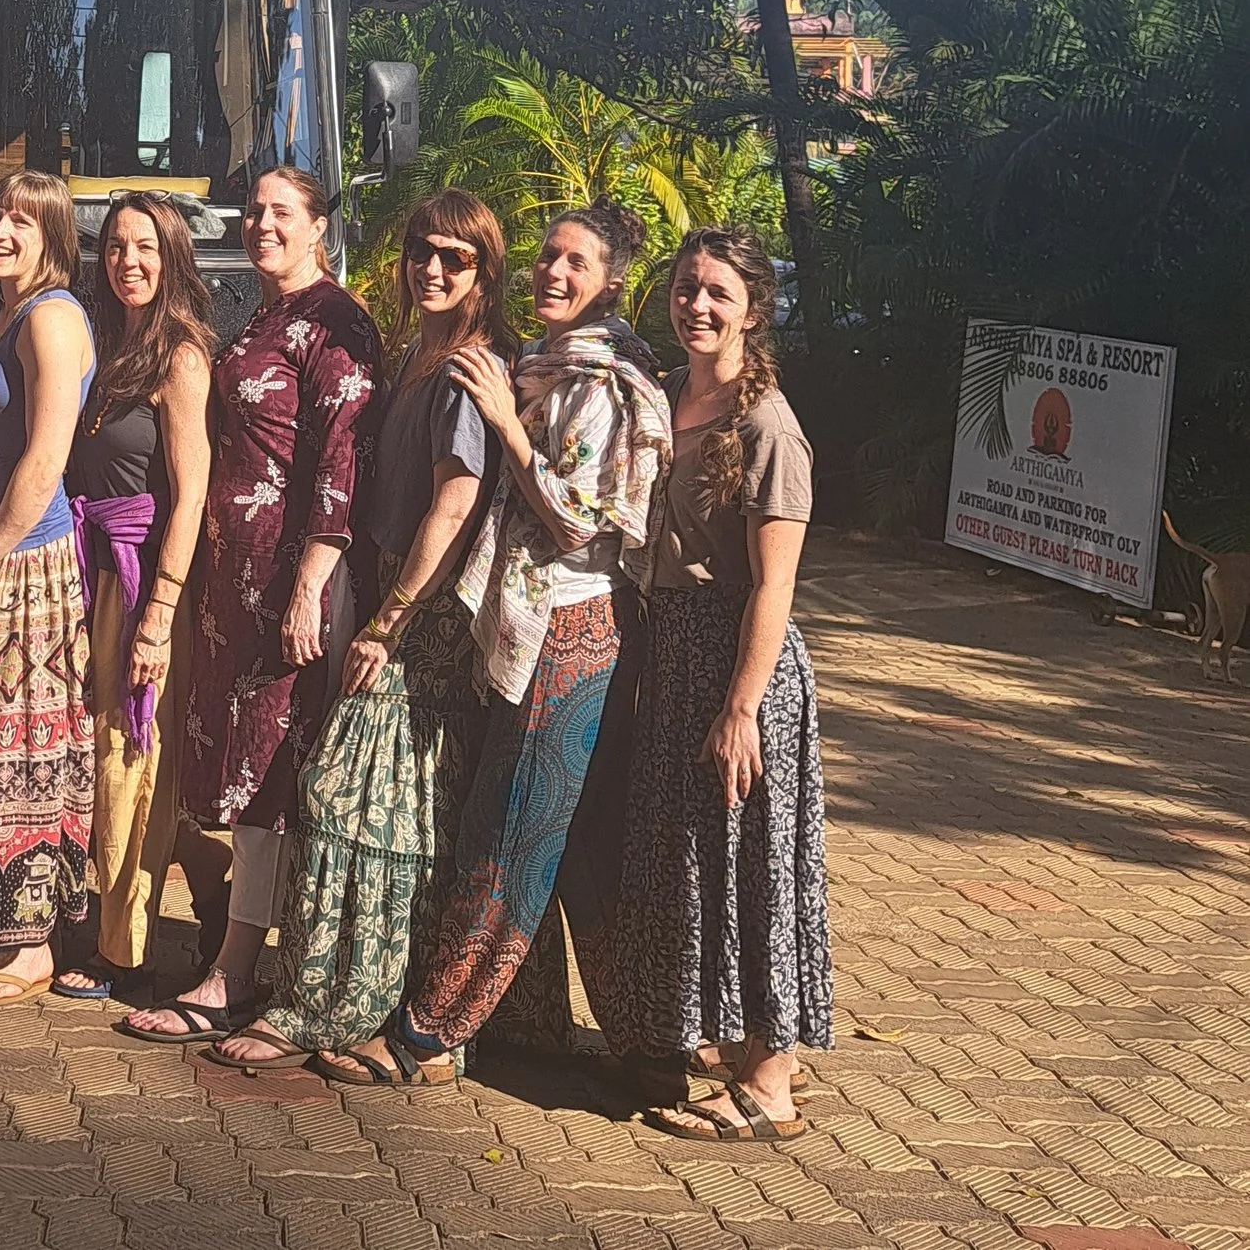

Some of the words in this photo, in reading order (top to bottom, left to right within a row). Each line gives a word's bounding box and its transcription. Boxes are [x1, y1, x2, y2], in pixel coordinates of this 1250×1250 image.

[1056, 337, 1083, 364] SPA
[1086, 342, 1098, 366] &
[1101, 344, 1165, 377] RESORT
[1058, 368, 1109, 391] 88806
[1010, 456, 1084, 489] ARTHIGAMYA
[957, 490, 1019, 521] ARTHIGAMYA
[1020, 508, 1042, 527] AND
[1043, 514, 1114, 548] WATERFRONT
[1117, 536, 1141, 556] OLY
[986, 478, 1013, 498] ROAD
[1015, 487, 1036, 504] AND
[1037, 492, 1083, 518] PARKING
[1085, 505, 1107, 525] FOR
[955, 513, 990, 540] OTHER
[992, 524, 1027, 551] GUEST
[1029, 535, 1070, 565] PLEASE
[1072, 548, 1103, 576] TURN
[1105, 558, 1139, 588] BACK
